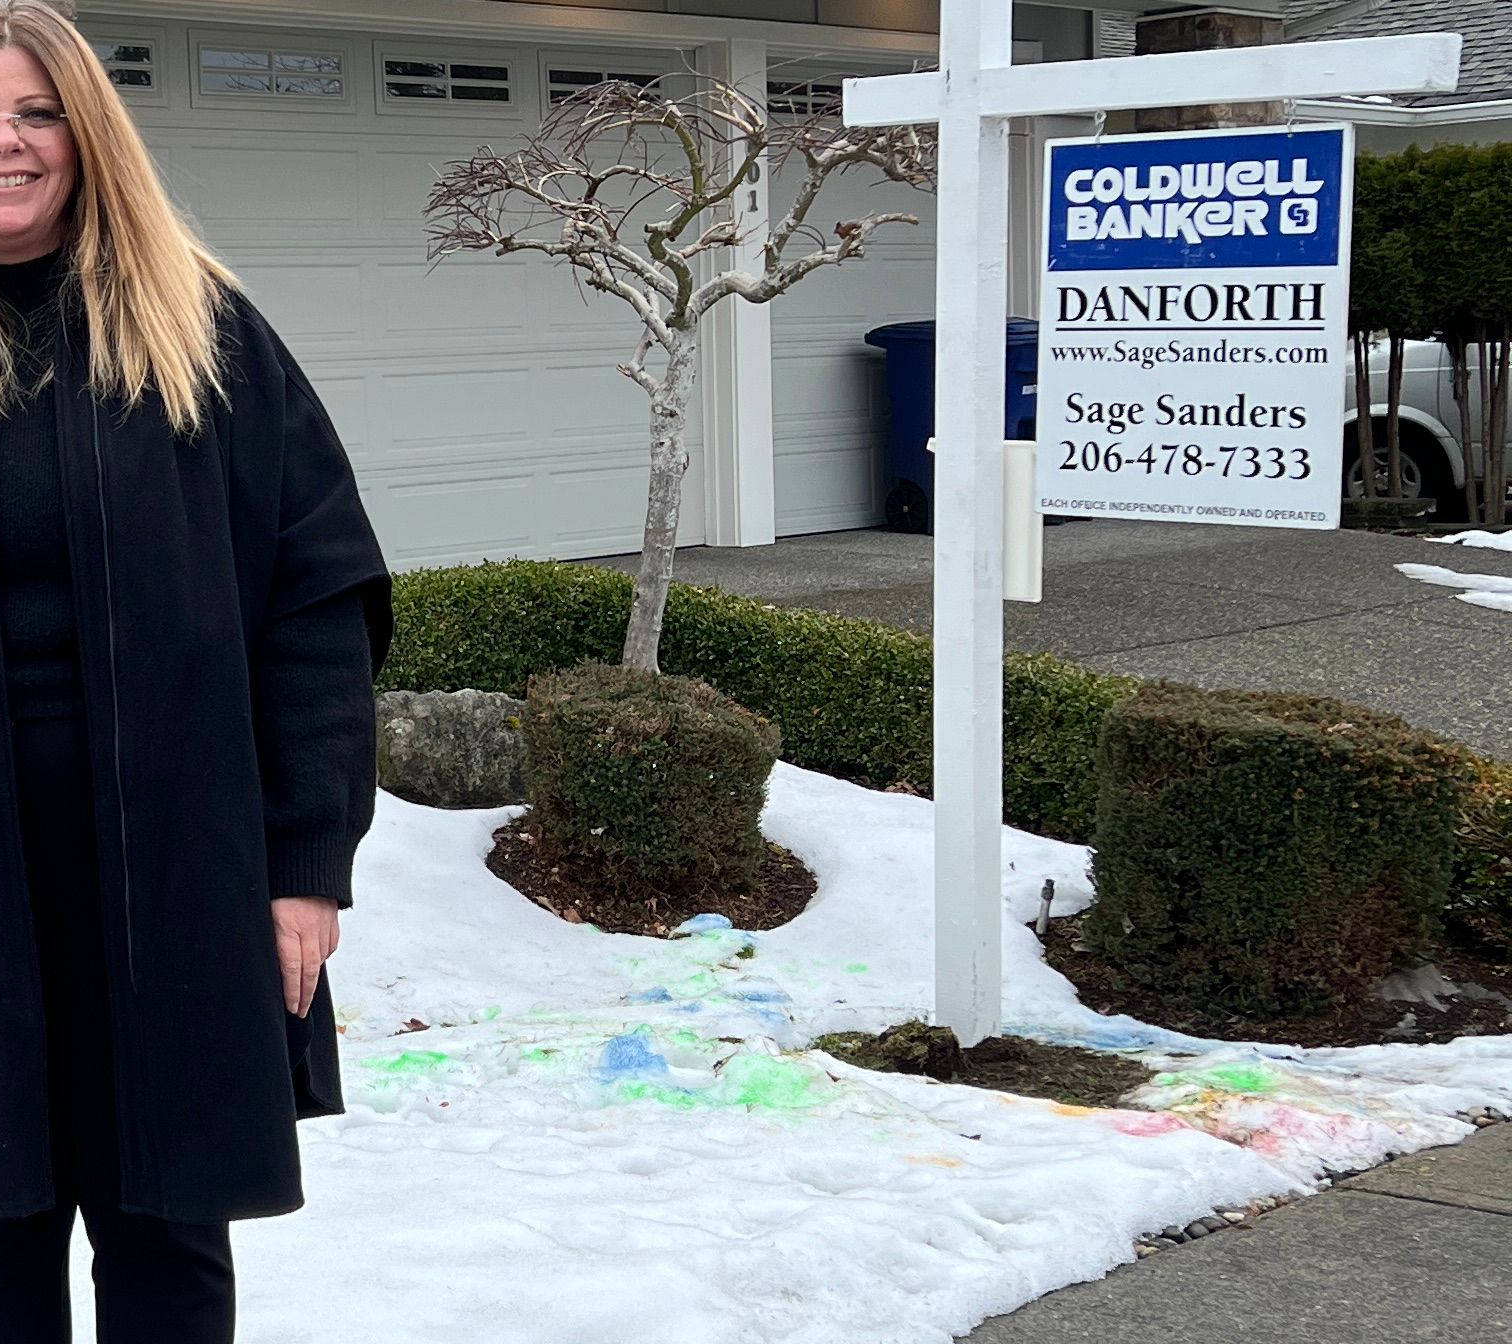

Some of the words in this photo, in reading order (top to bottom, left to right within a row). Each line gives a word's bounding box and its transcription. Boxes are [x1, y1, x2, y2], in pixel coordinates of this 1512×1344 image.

[1064, 158, 1324, 204] COLDWELL
[1066, 199, 1269, 244] BANKER
[1056, 283, 1326, 322] DANFORTH
[1050, 339, 1328, 369] www.SageSanders.com
[1065, 392, 1145, 434] Sage
[1155, 393, 1306, 429] Sanders
[1058, 440, 1311, 480] 206-478-7333
[1041, 498, 1068, 508] EACH
[1070, 500, 1107, 511] OFFICE
[1109, 501, 1193, 515] INDEPENDENTLY
[1196, 505, 1237, 517] OWNED
[1239, 508, 1262, 518] AND
